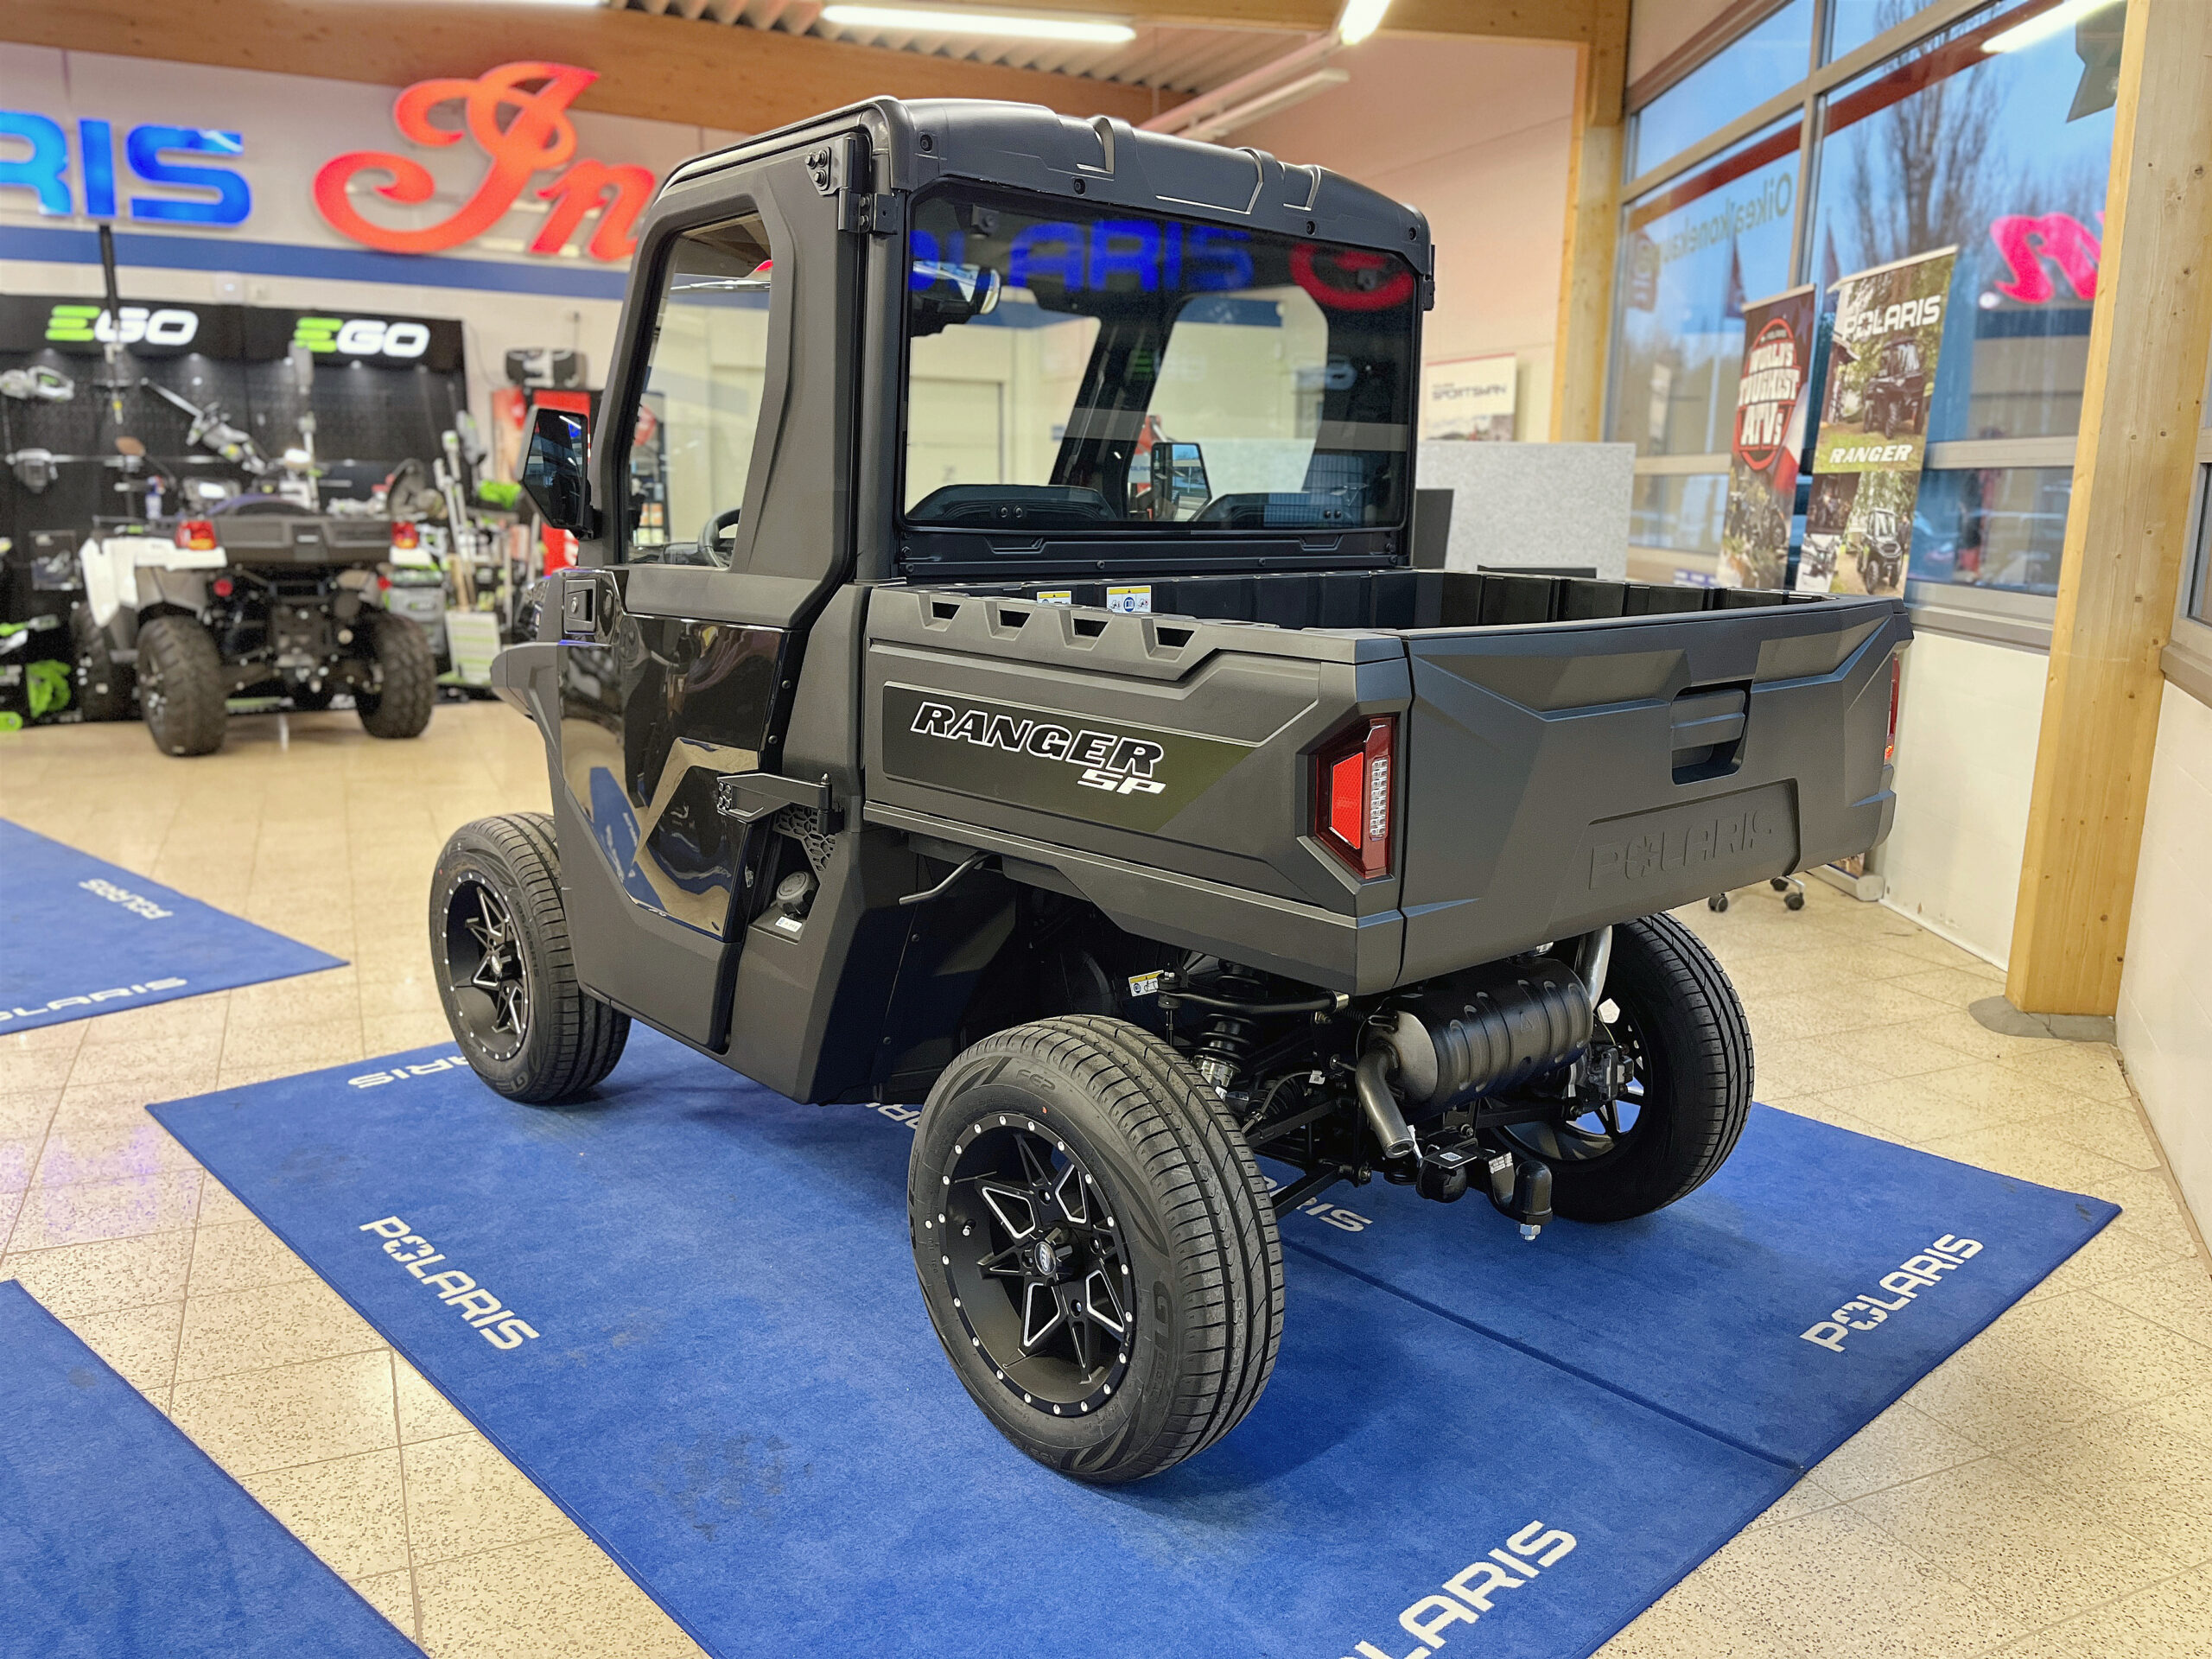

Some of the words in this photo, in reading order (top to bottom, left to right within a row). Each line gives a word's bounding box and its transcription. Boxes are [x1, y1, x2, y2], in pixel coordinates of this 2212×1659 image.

[45, 305, 200, 346] EGO
[293, 317, 431, 357] EGO
[1840, 295, 1942, 340] POLARIS
[1829, 443, 1913, 464] RANGER
[910, 702, 1165, 778] RANGER
[1077, 768, 1166, 795] SP
[1588, 810, 1774, 891] POLARIS
[359, 1216, 540, 1350] POLARIS
[1799, 1233, 1984, 1353] POLARIS
[1339, 1520, 1577, 1659] LARIS
